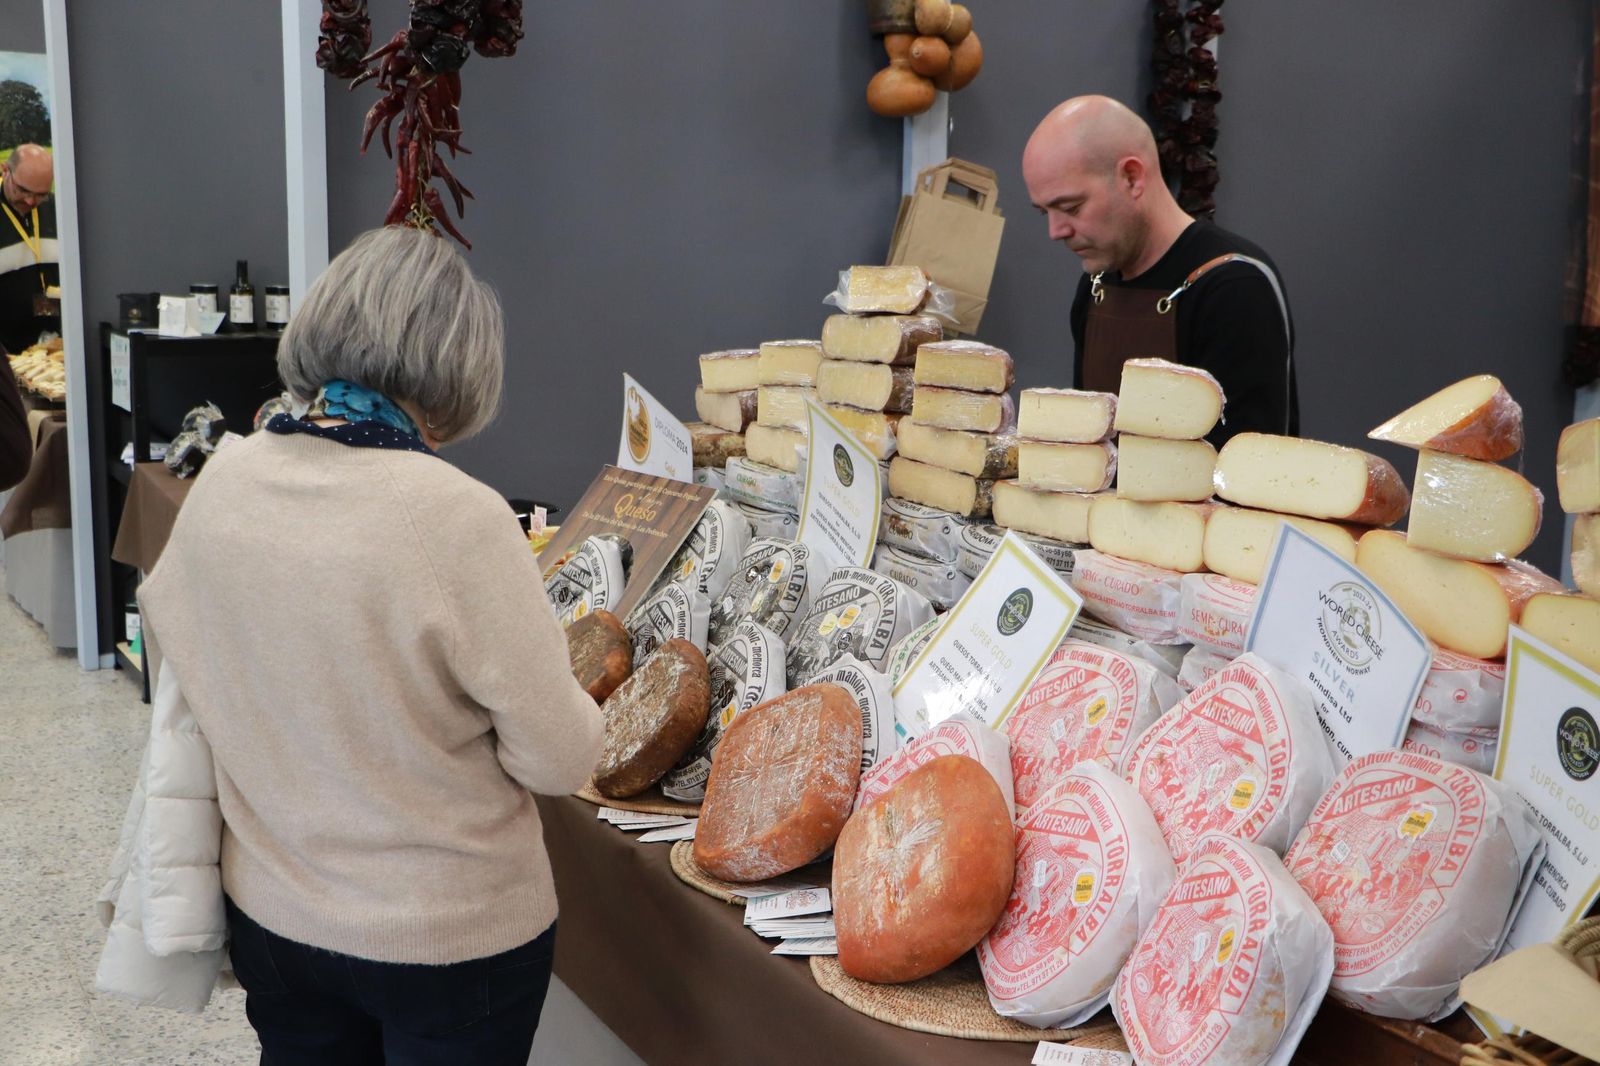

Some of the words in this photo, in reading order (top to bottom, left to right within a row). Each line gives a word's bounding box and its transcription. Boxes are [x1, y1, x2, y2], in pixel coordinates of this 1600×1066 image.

[614, 494, 656, 522] Queso
[890, 569, 917, 588] CURADO
[1082, 568, 1097, 583] SEMI
[1104, 576, 1140, 596] CURADO
[812, 586, 860, 616] ARTESANO
[870, 579, 895, 650] TORRALBA
[1124, 603, 1158, 615] TORRALBA
[1318, 589, 1356, 628] WORLD
[1355, 624, 1384, 660] CHEESE
[953, 639, 970, 660] QUESOS
[1316, 616, 1343, 665] TRONDHEIM
[1346, 665, 1371, 676] NORWAY
[1331, 630, 1360, 660] AWARDS
[940, 656, 955, 674] QUESO
[1312, 651, 1356, 703] SILVER
[1023, 668, 1086, 710] ARTESANO
[1107, 656, 1135, 742] TORRALBA
[1189, 680, 1217, 704] queso
[1308, 671, 1338, 709] Brindisa
[1338, 706, 1353, 725] Ltd
[1202, 699, 1257, 736] ARTESANO
[1320, 702, 1330, 714] for
[1336, 740, 1354, 761] cure
[1333, 776, 1417, 816] ARTESANO
[1528, 764, 1564, 799] SUPER
[1566, 795, 1600, 832] GOLD
[1032, 812, 1092, 836] ARTESANO
[1314, 781, 1341, 817] queso
[1439, 767, 1481, 873] TORRALBA
[1539, 813, 1571, 852] TORRALBA,
[1022, 795, 1051, 822] queso
[1075, 833, 1125, 942] TORRALBA
[1543, 859, 1570, 892] MENORCA
[1173, 876, 1232, 903] ARTESANO
[1545, 884, 1567, 912] CURADO
[1225, 881, 1267, 999] TORRALBA
